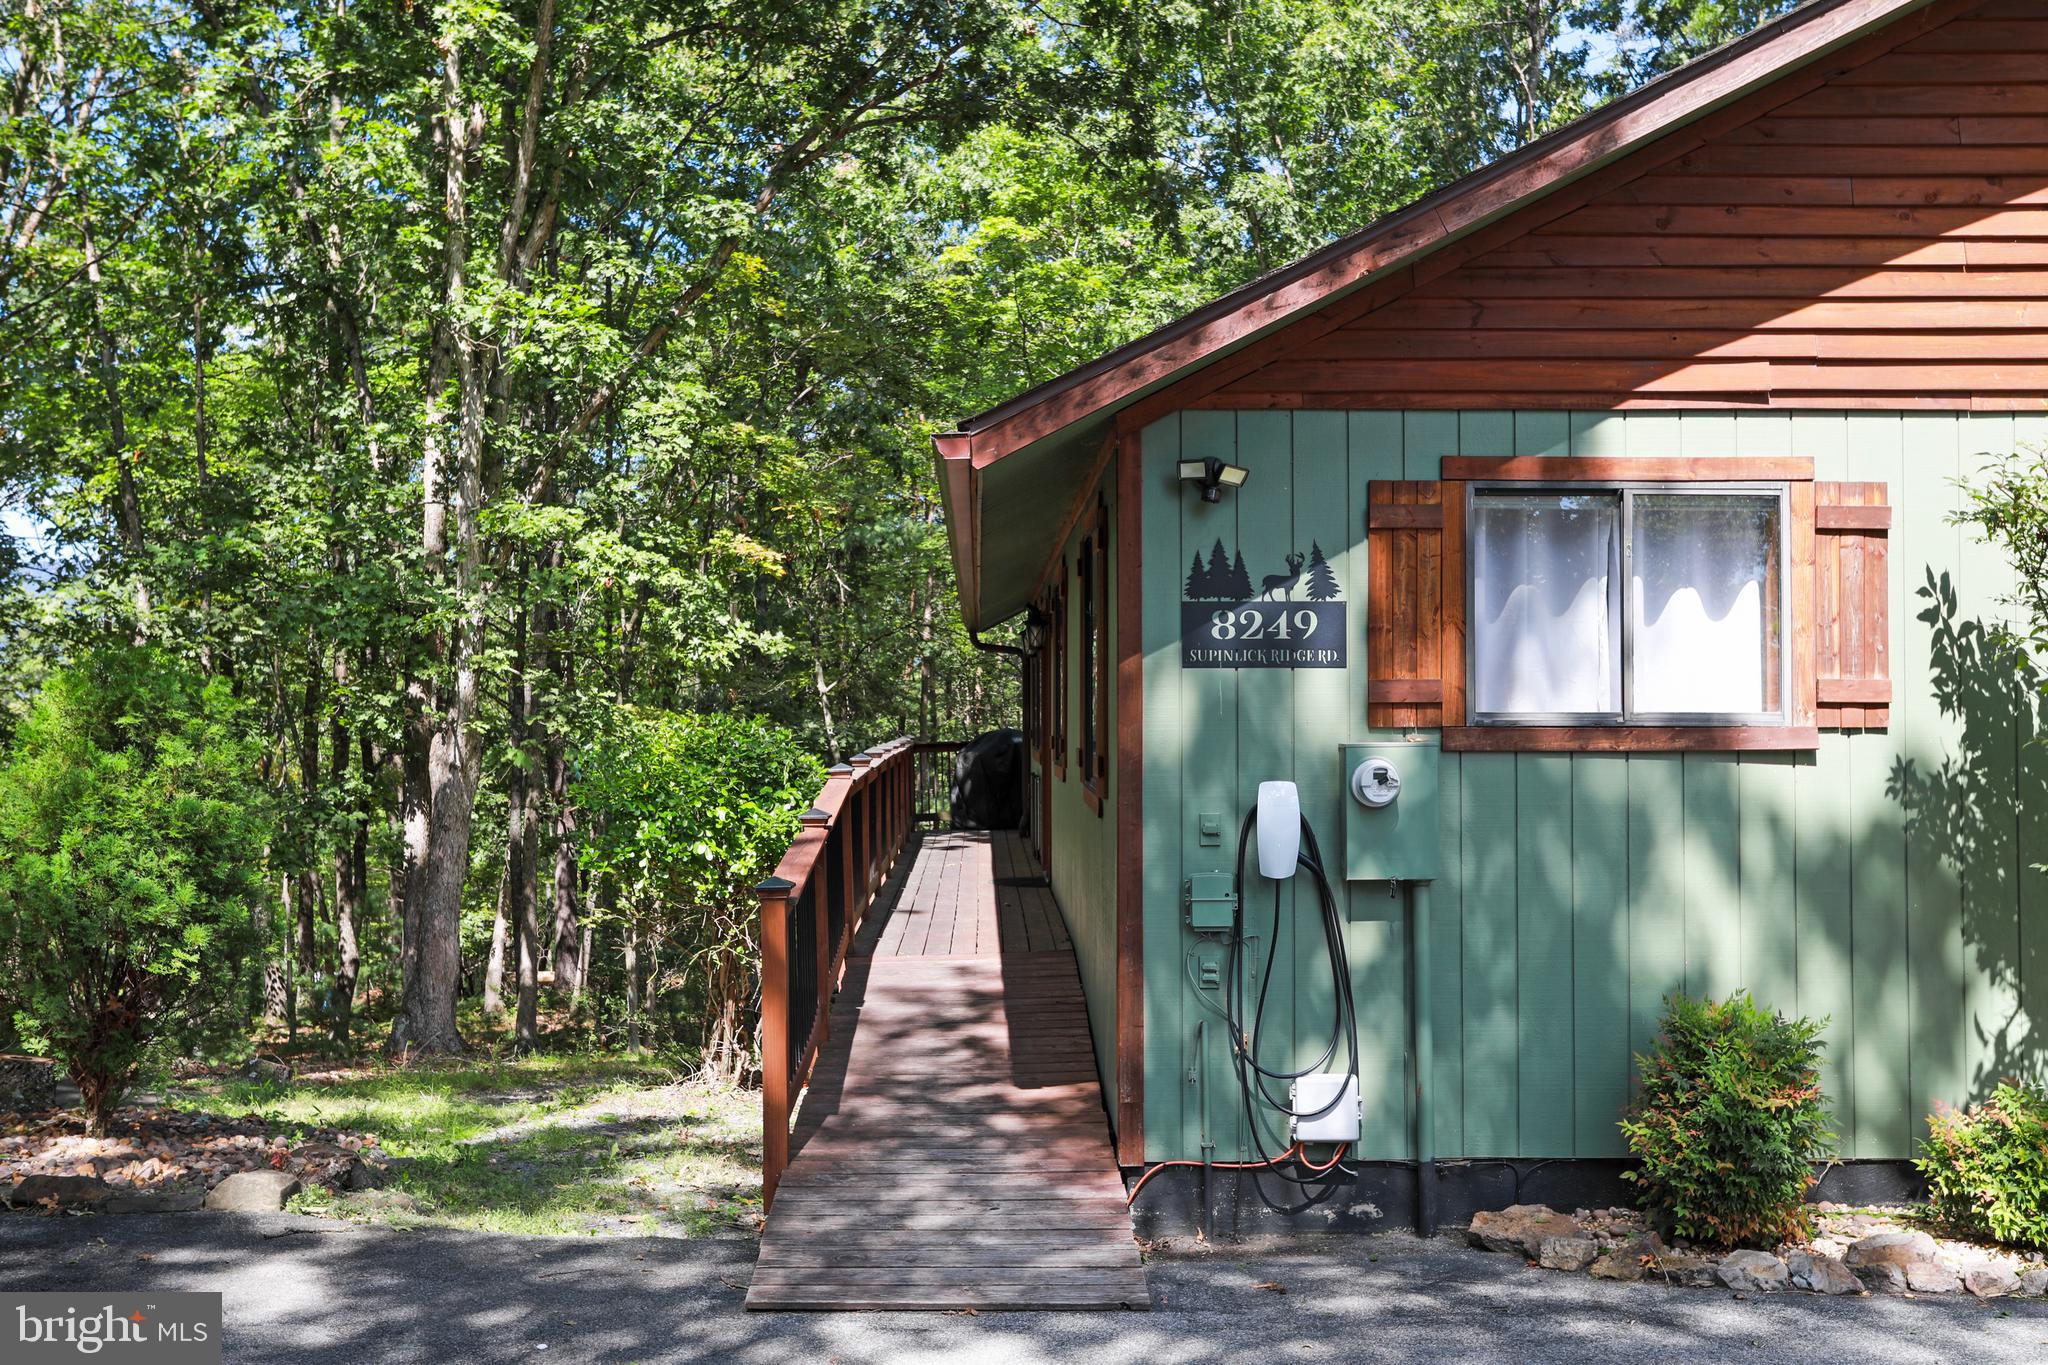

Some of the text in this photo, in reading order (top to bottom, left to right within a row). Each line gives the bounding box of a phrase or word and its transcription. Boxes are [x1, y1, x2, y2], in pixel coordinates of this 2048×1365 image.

[1211, 609, 1318, 640] 8249
[1190, 649, 1340, 664] SUPINLICK RIDGE RD.
